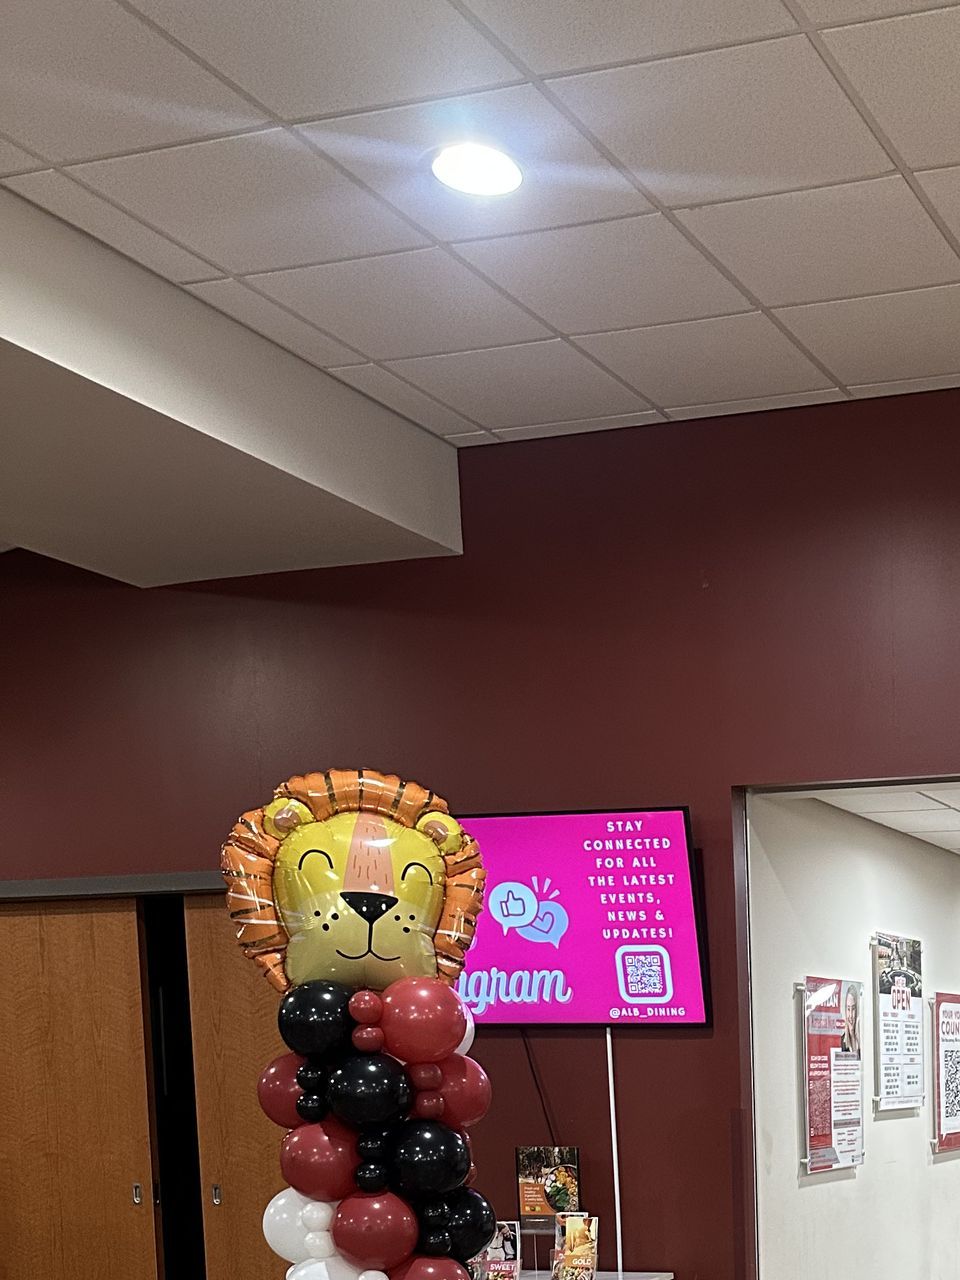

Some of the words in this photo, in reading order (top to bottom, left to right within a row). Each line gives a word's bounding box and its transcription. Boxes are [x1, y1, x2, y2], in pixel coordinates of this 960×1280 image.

[606, 820, 643, 832] STAY
[583, 837, 671, 851] CONNECTED
[596, 857, 625, 869] FOR
[632, 856, 657, 868] ALL
[588, 875, 615, 887] THE
[623, 873, 675, 886] LATEST
[600, 892, 661, 904] EVENTS,
[607, 910, 647, 922] NEWS
[655, 910, 665, 921] &
[602, 927, 673, 939] UPDATES!
[892, 989, 911, 1011] OPEN
[609, 1007, 686, 1019] @ALB_DINING
[942, 1010, 953, 1020] YOUR
[490, 1263, 515, 1271] SWEET
[572, 1258, 592, 1266] GOLD
